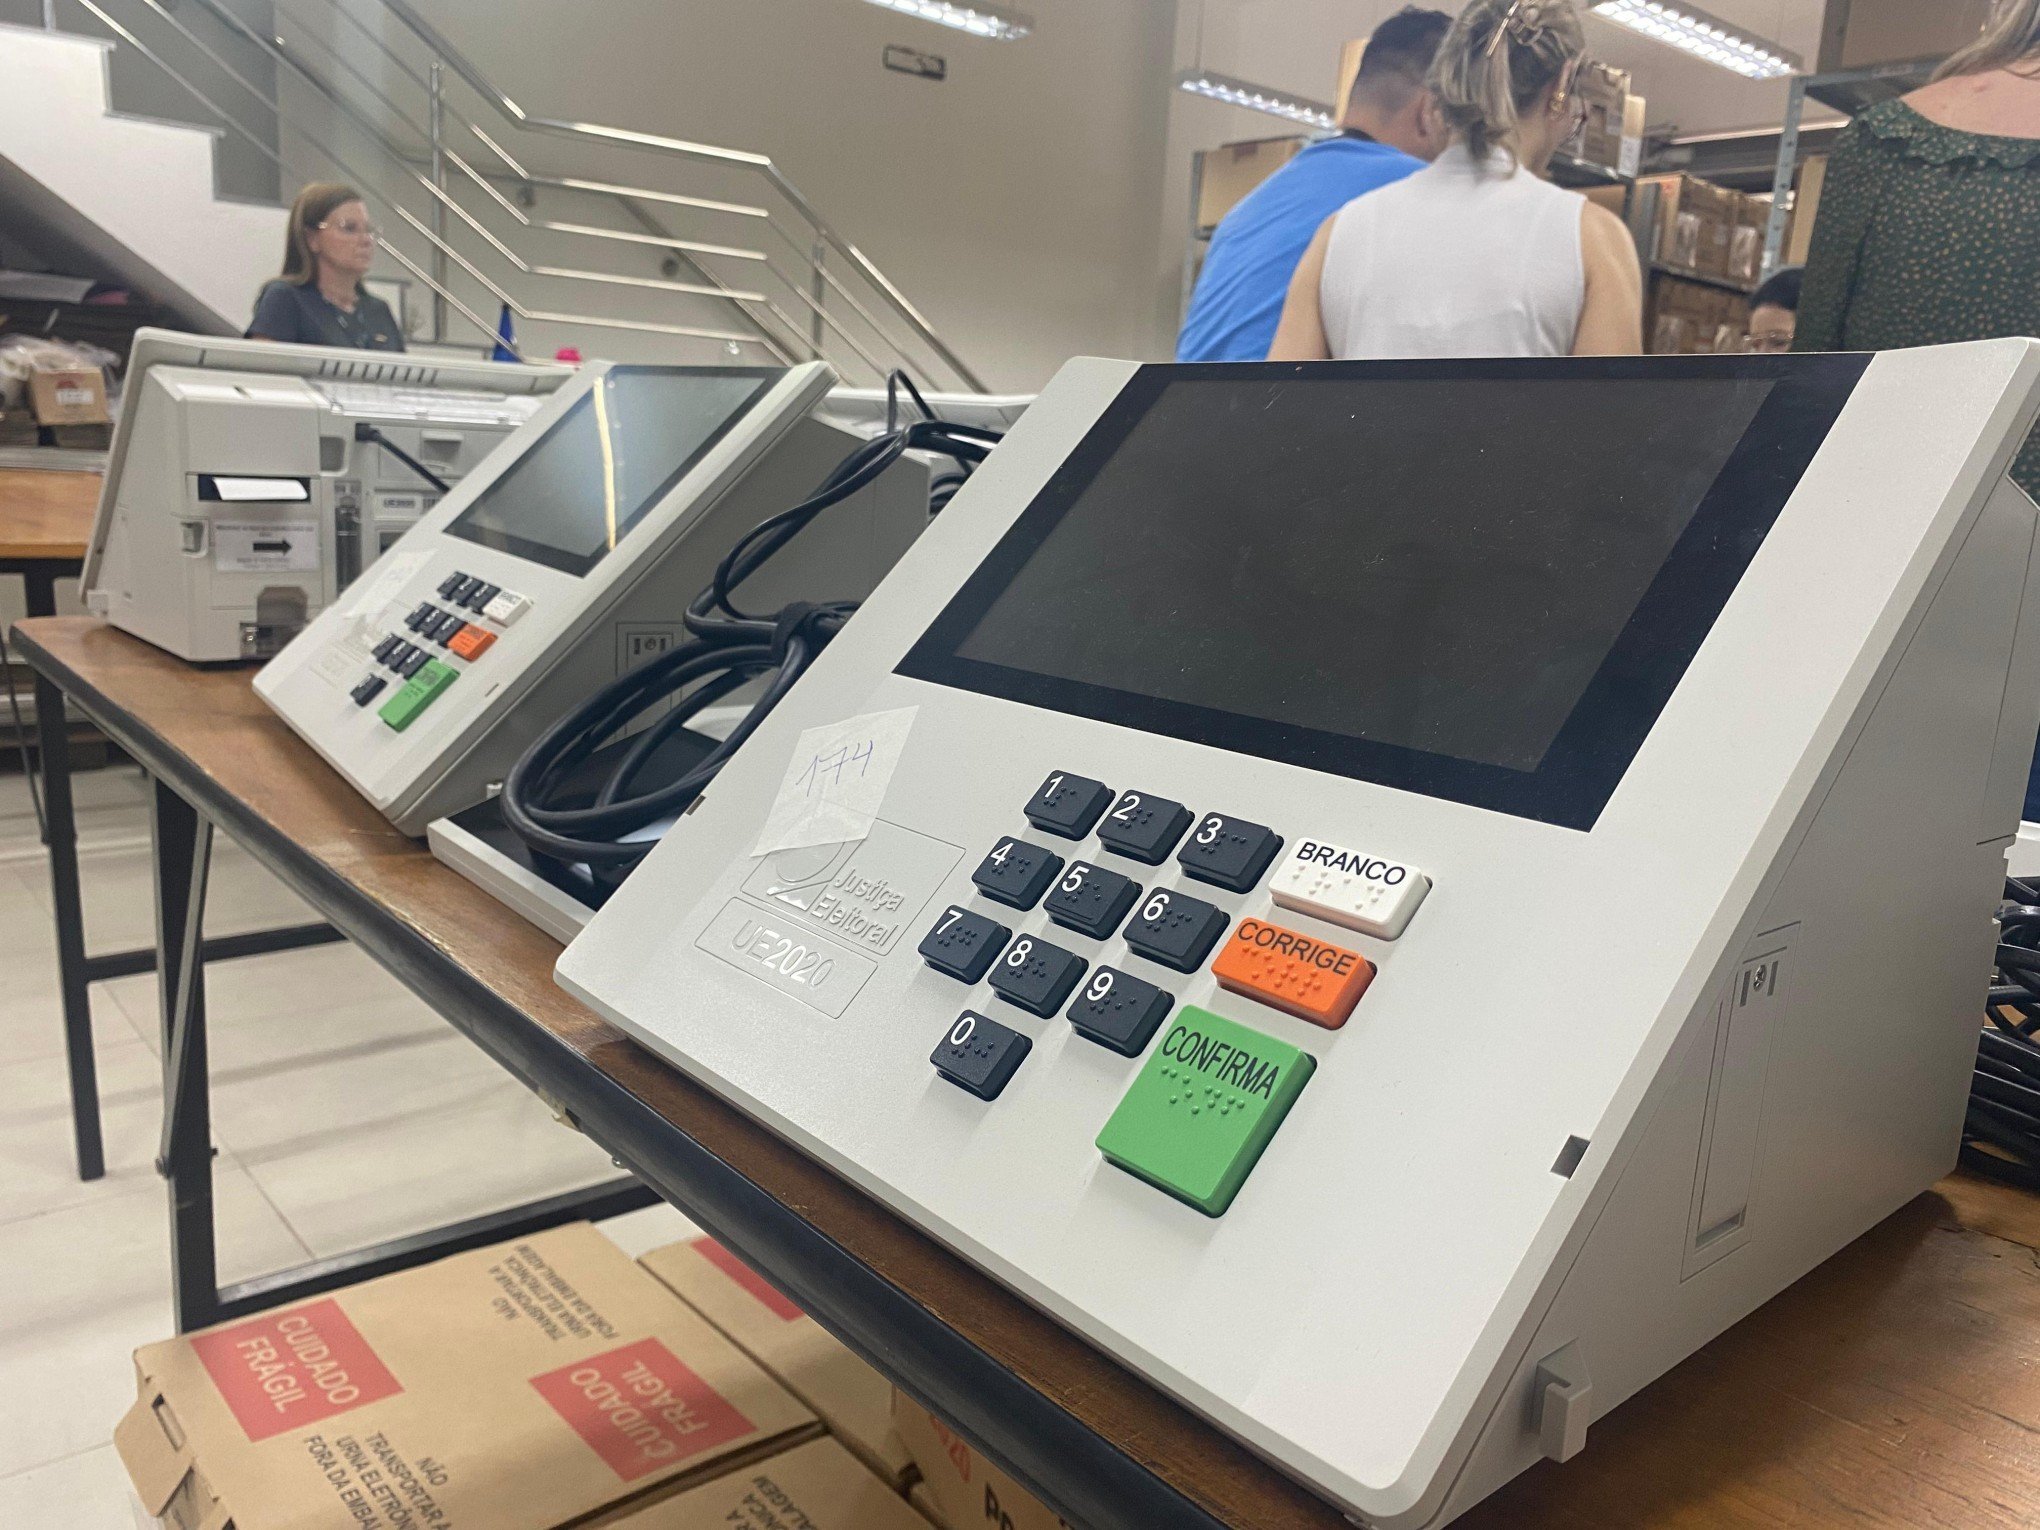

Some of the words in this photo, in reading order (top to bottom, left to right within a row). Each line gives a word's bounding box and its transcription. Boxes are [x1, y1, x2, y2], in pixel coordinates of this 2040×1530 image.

[1043, 775, 1063, 797] 1
[1112, 795, 1141, 820] 2
[1196, 817, 1223, 844] 3
[833, 868, 904, 911] Justiça
[990, 842, 1014, 866] 4
[1061, 866, 1089, 892] 5
[1141, 893, 1170, 920] 6
[1295, 841, 1407, 886] BRANCO
[730, 919, 837, 987] UE2020
[810, 891, 899, 947] Eleitoral
[1237, 921, 1357, 976] CORRIGE
[935, 910, 963, 936] 7
[1006, 939, 1033, 966] 8
[1086, 972, 1113, 1001] 9
[950, 1016, 976, 1045] 0
[1161, 1025, 1281, 1100] CONFIRMA
[236, 1335, 306, 1414] FRÁGIL
[277, 1315, 361, 1405] CUIDADO
[569, 1367, 676, 1460] CUIDADO
[621, 1360, 709, 1435] FRÁGIL
[303, 1434, 338, 1472] FORA
[326, 1468, 351, 1491] DA
[336, 1434, 371, 1473] URNA
[365, 1430, 444, 1524] TRANSPORTAR
[415, 1457, 448, 1486] NÃO
